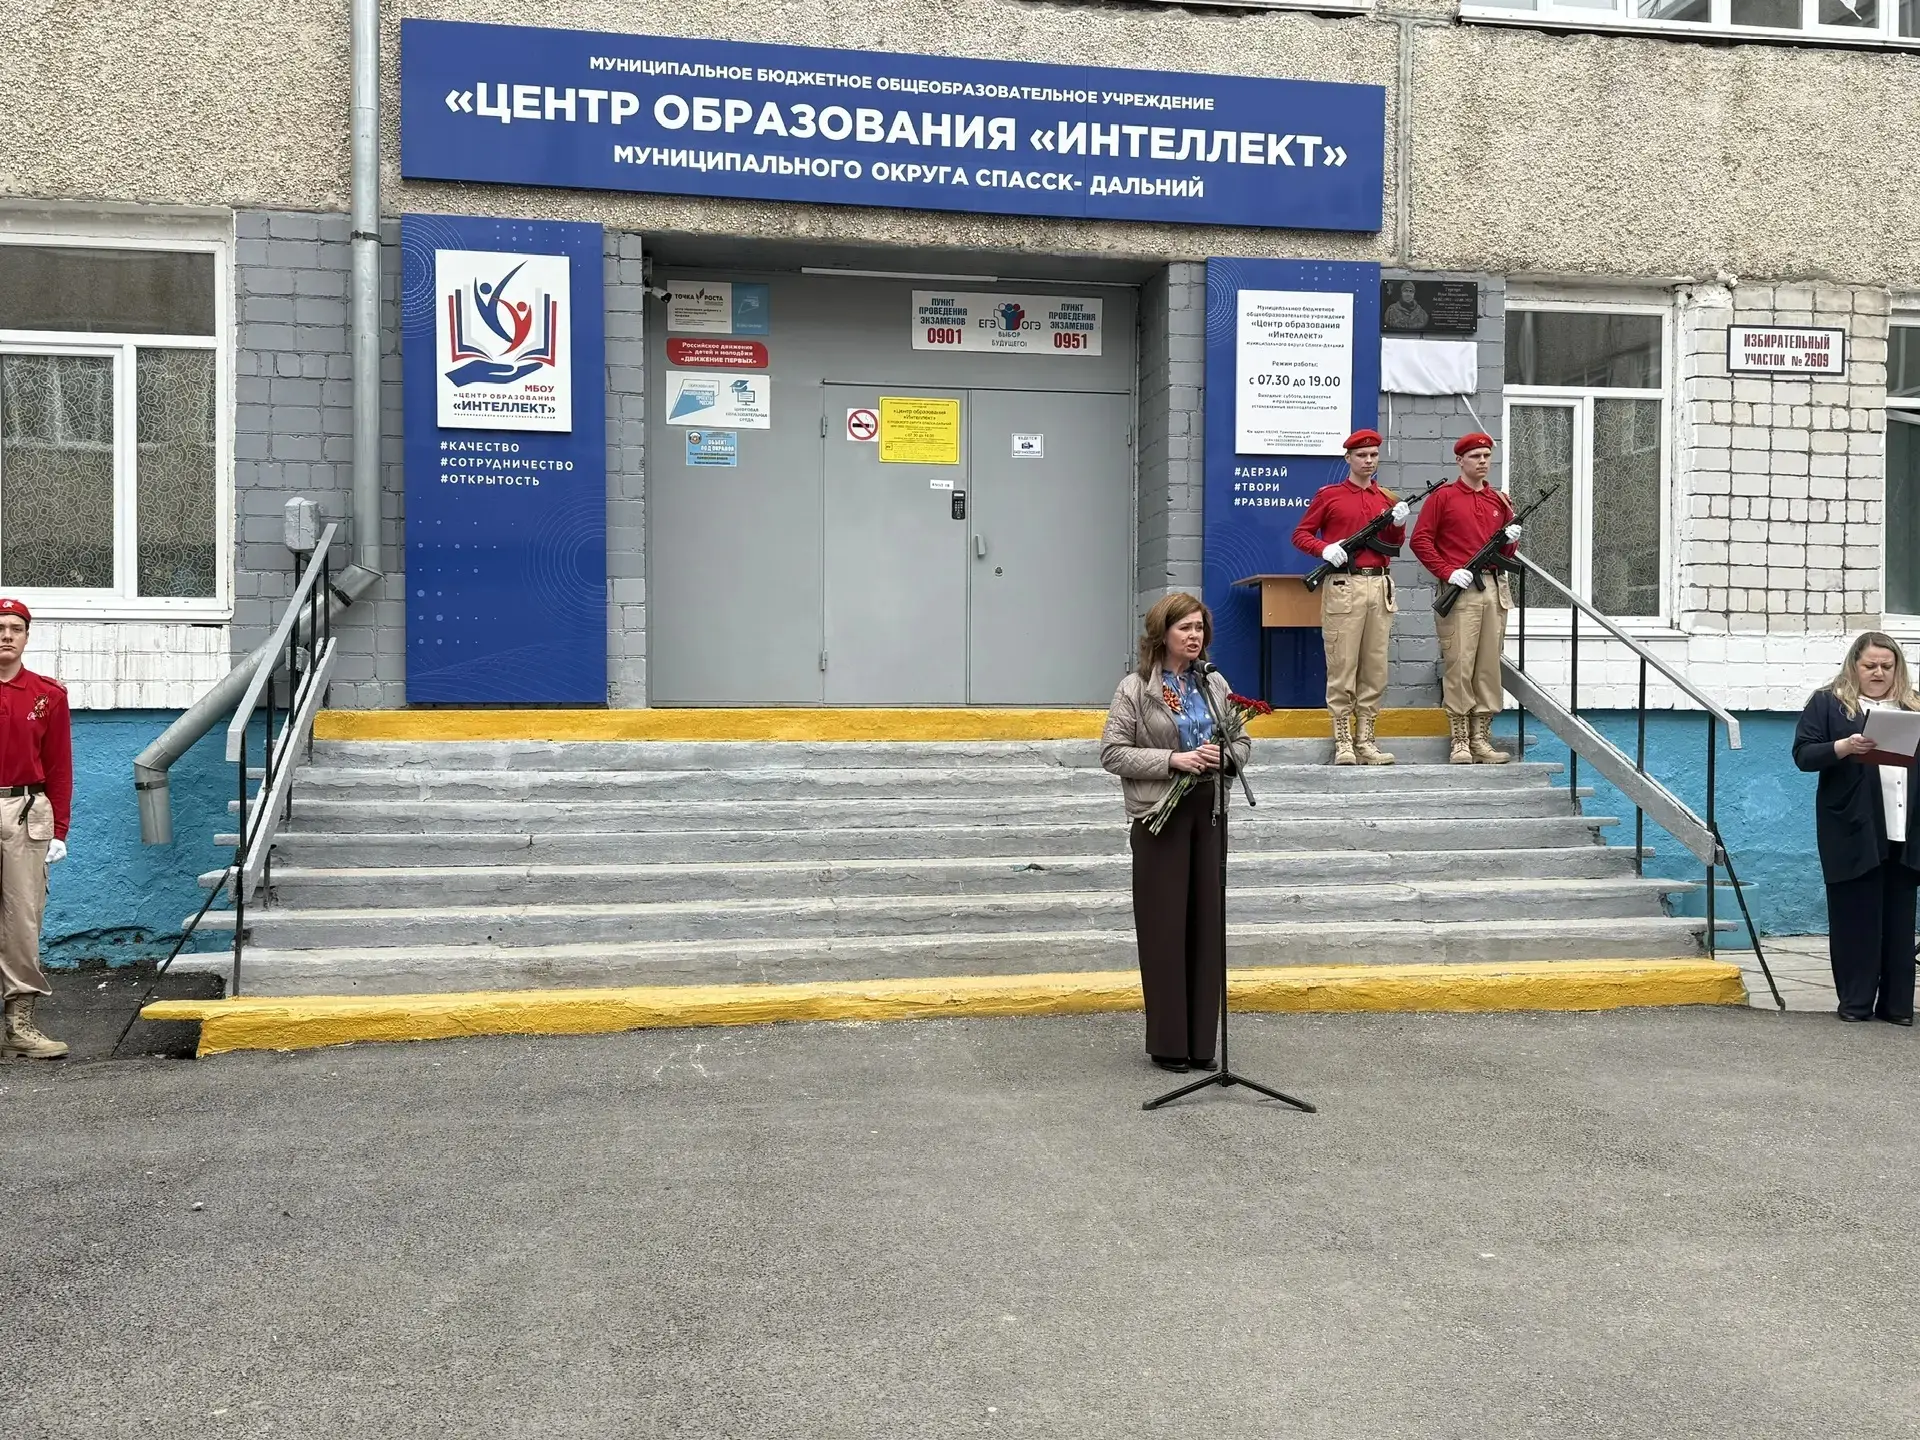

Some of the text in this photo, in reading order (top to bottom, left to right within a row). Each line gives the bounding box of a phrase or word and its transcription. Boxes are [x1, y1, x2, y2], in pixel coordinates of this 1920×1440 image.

[590, 56, 1214, 111] МУНИЦИПАЛЬНОЕ БЮДЖЕТНОЕ ОБЩЕОБРАЗОВАТЕЛЬНОЕ УЧРЕЖДЕНИЕ
[445, 82, 1347, 168] «ЦЕНТР ОБРАЗОВАНИЯ «ИНТЕЛЛЕКТ»
[613, 144, 1204, 198] МУНИЦИПАЛЬНОГО ОКРУГА СПАССК- ДАЛЬНИЙ
[931, 298, 955, 307] ПУНКТ
[1061, 303, 1084, 311] ПУНКТ
[919, 307, 968, 316] ПРОВЕДЕНИЯ
[1049, 312, 1096, 321] ПРОВЕДЕНИЯ
[920, 316, 966, 326] ЭКЗАМЕНОВ
[979, 319, 1041, 330] ЕГЭ ОГЭ
[1050, 322, 1094, 331] ЭКЗАМЕНОВ
[1252, 320, 1340, 329] «Центр образования
[927, 328, 962, 344] 0901
[1054, 332, 1087, 349] 0951
[1269, 331, 1323, 339] «Интеллект»
[991, 339, 1028, 347] БУДУЩЕГО!
[1744, 334, 1830, 349] ИЗБИРАТЕЛЬНЫЙ
[1745, 353, 1829, 367] УЧАСТОК № 2609
[1258, 374, 1289, 385] 07.30
[1293, 379, 1305, 387] до
[1309, 376, 1340, 387] 19.00
[453, 401, 555, 413] «ИНТЕЛЛЕКТ»
[440, 441, 520, 452] #КАЧЕСТВО
[441, 458, 573, 471] #СОТРУДНИЧЕСТВО
[1235, 466, 1287, 477] #ДЕРЗАЙ
[441, 474, 539, 486] #ОТКРЫТОСТЬ
[1235, 483, 1279, 491] #ТВОРИ
[1234, 497, 1313, 507] #РАЗВИВАЙС
